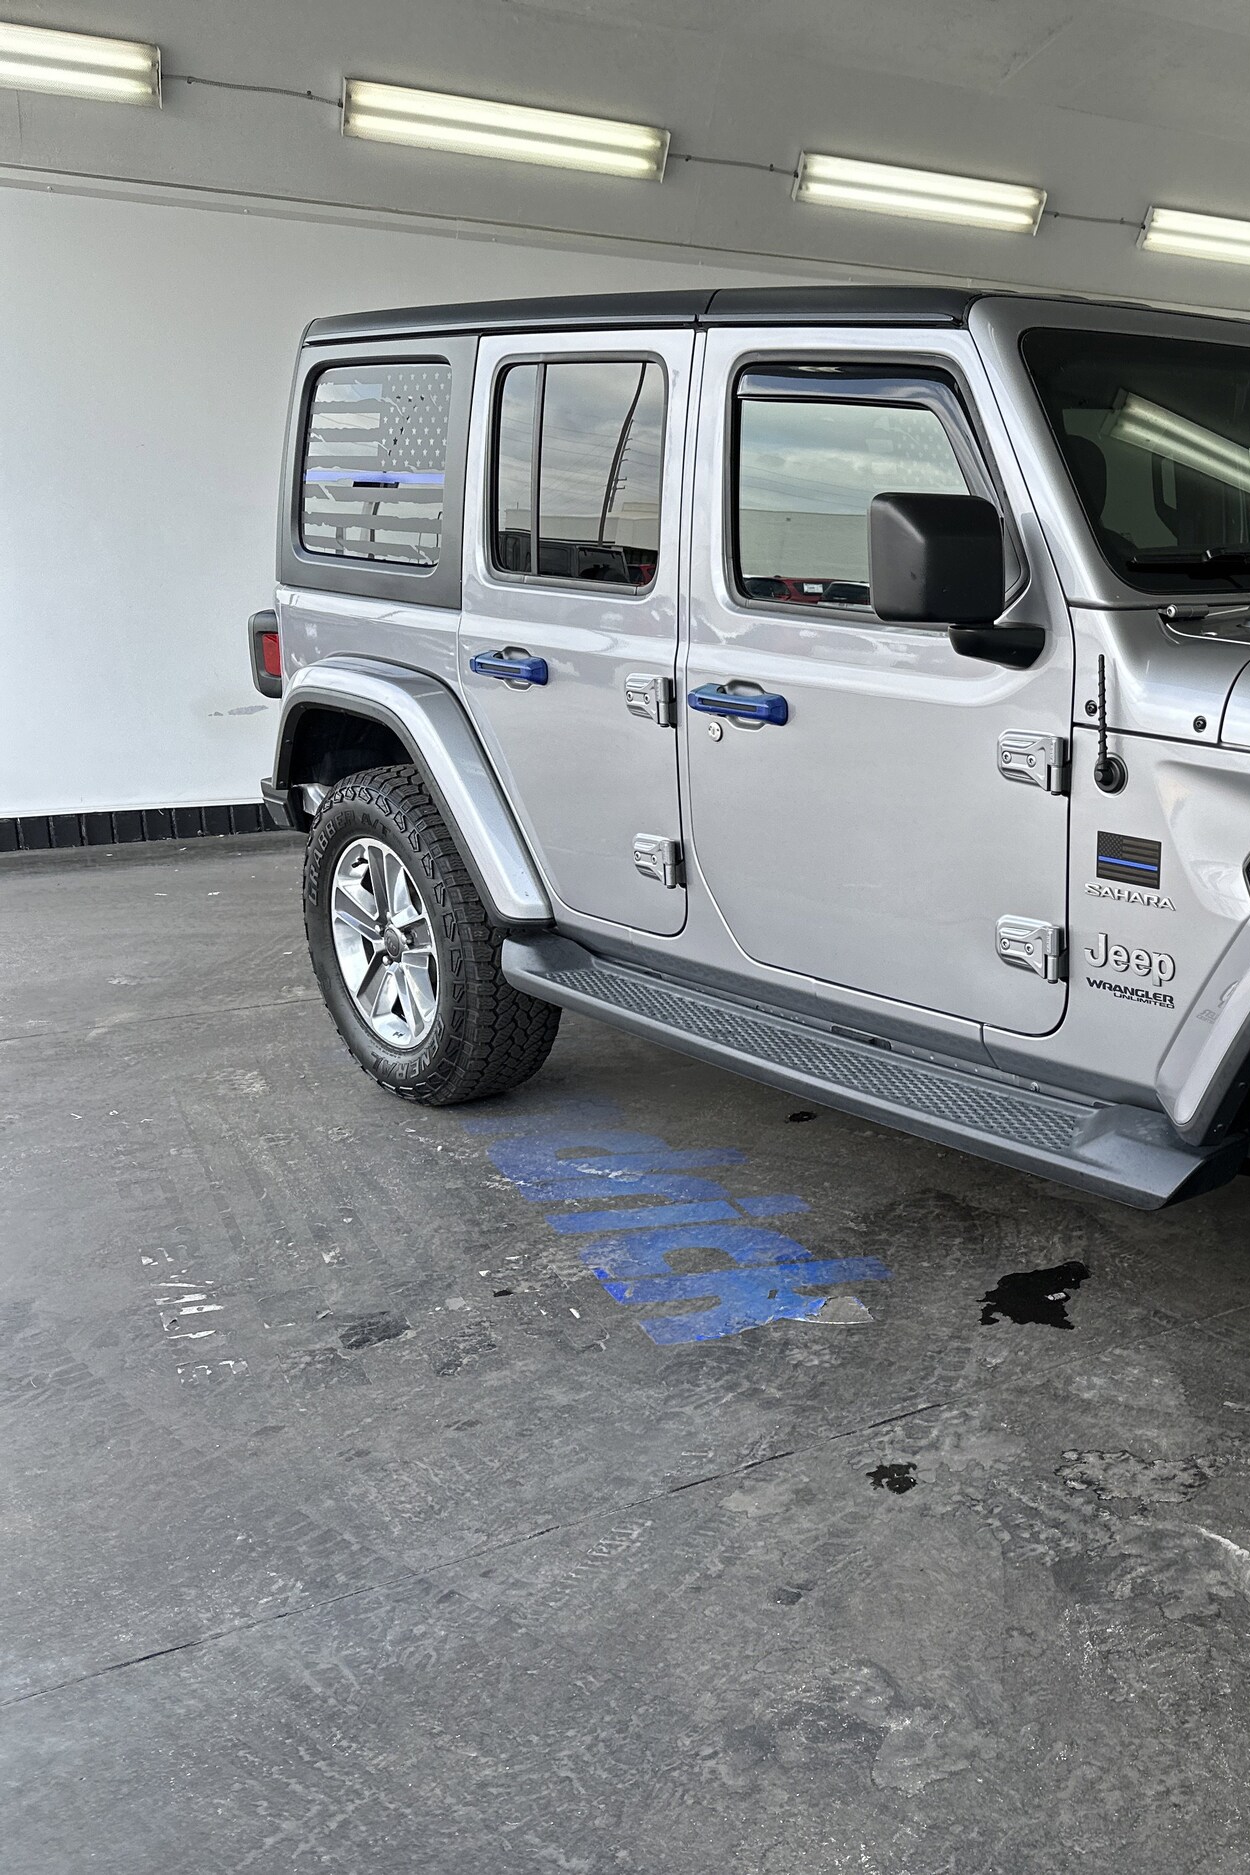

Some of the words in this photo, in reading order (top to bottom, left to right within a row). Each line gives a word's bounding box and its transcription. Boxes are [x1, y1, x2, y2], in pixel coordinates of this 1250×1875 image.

[308, 810, 356, 907] GRABBER
[1084, 883, 1176, 911] SAHARA
[1084, 932, 1175, 987] Jeep
[1086, 976, 1174, 1005] WRANGLER
[1113, 991, 1175, 1009] UNLIMITED
